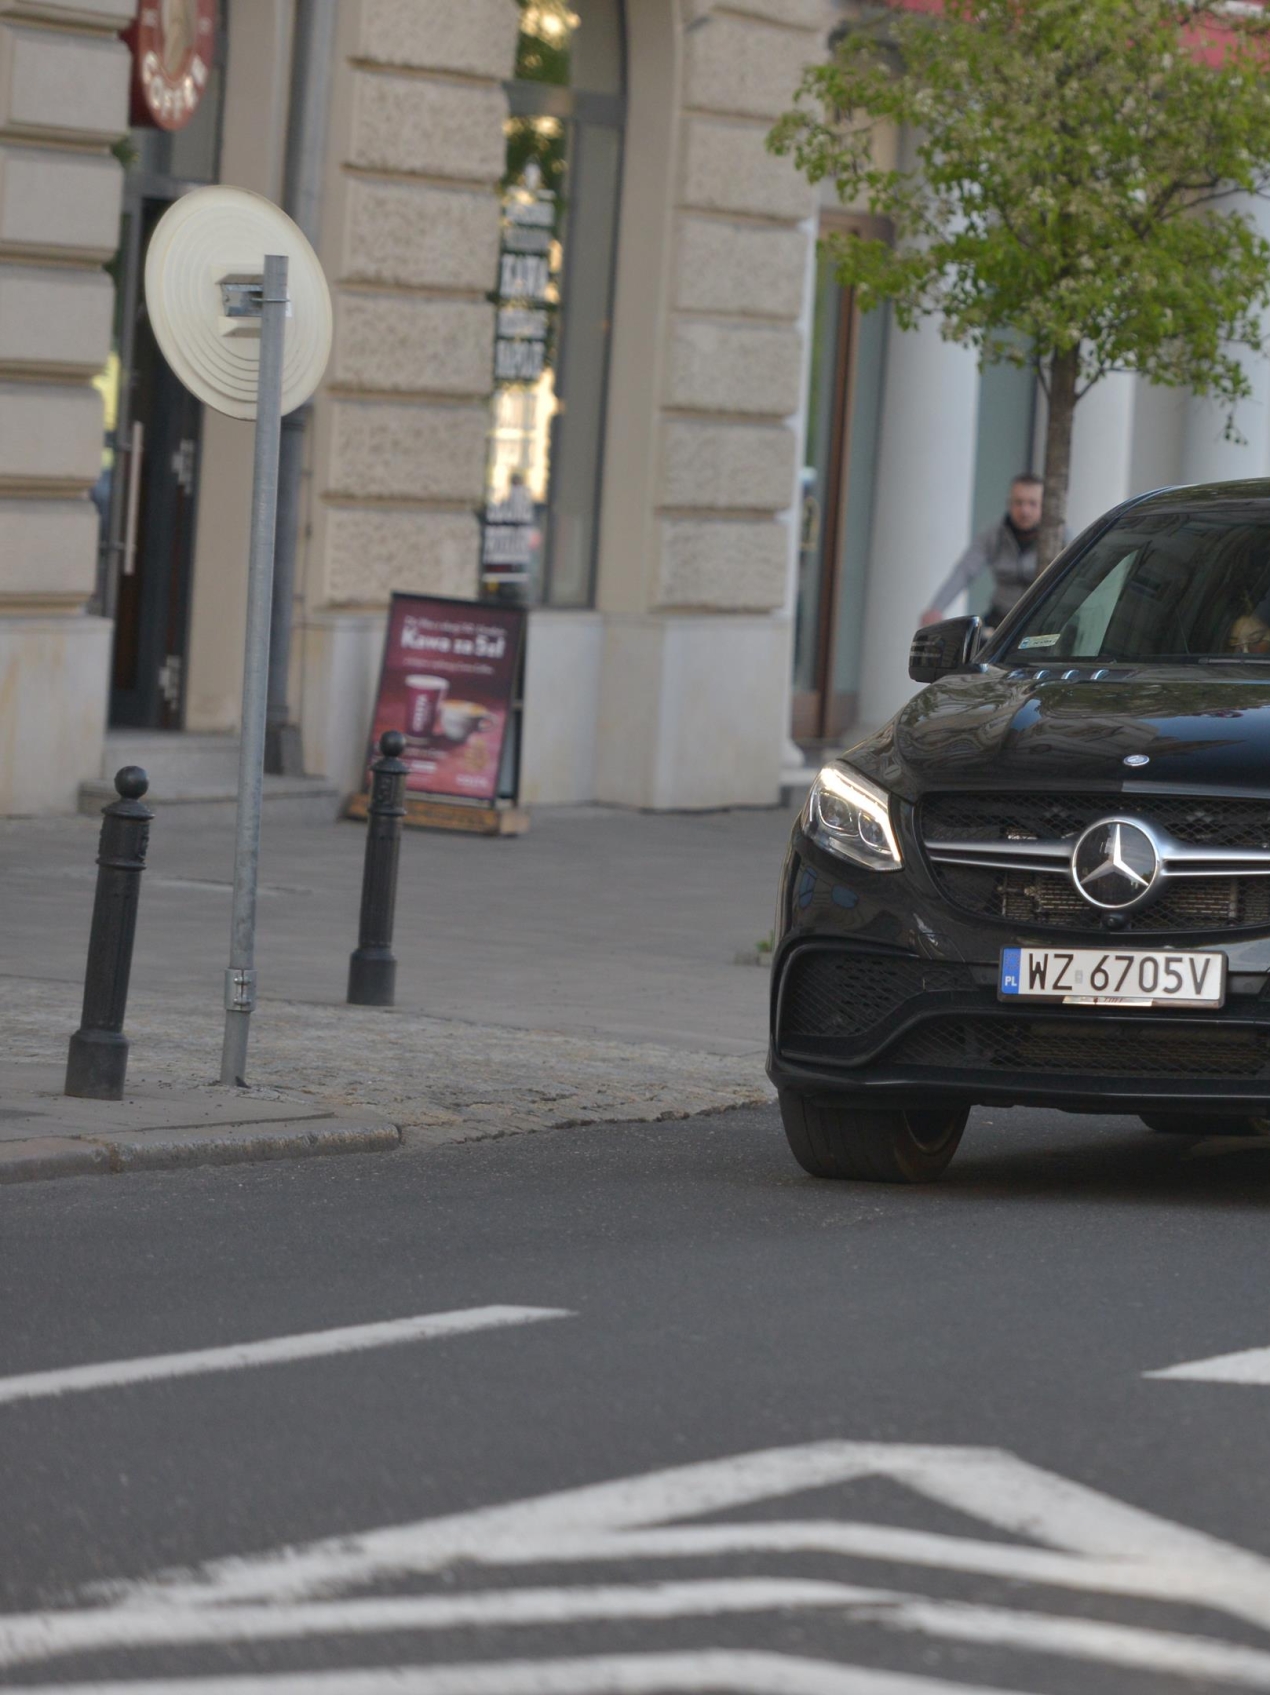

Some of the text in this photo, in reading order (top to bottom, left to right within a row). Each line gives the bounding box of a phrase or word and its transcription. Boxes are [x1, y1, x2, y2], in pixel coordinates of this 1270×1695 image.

[401, 626, 450, 653] Kawa
[1004, 976, 1018, 987] PL
[1028, 953, 1211, 995] WZ 6705V
